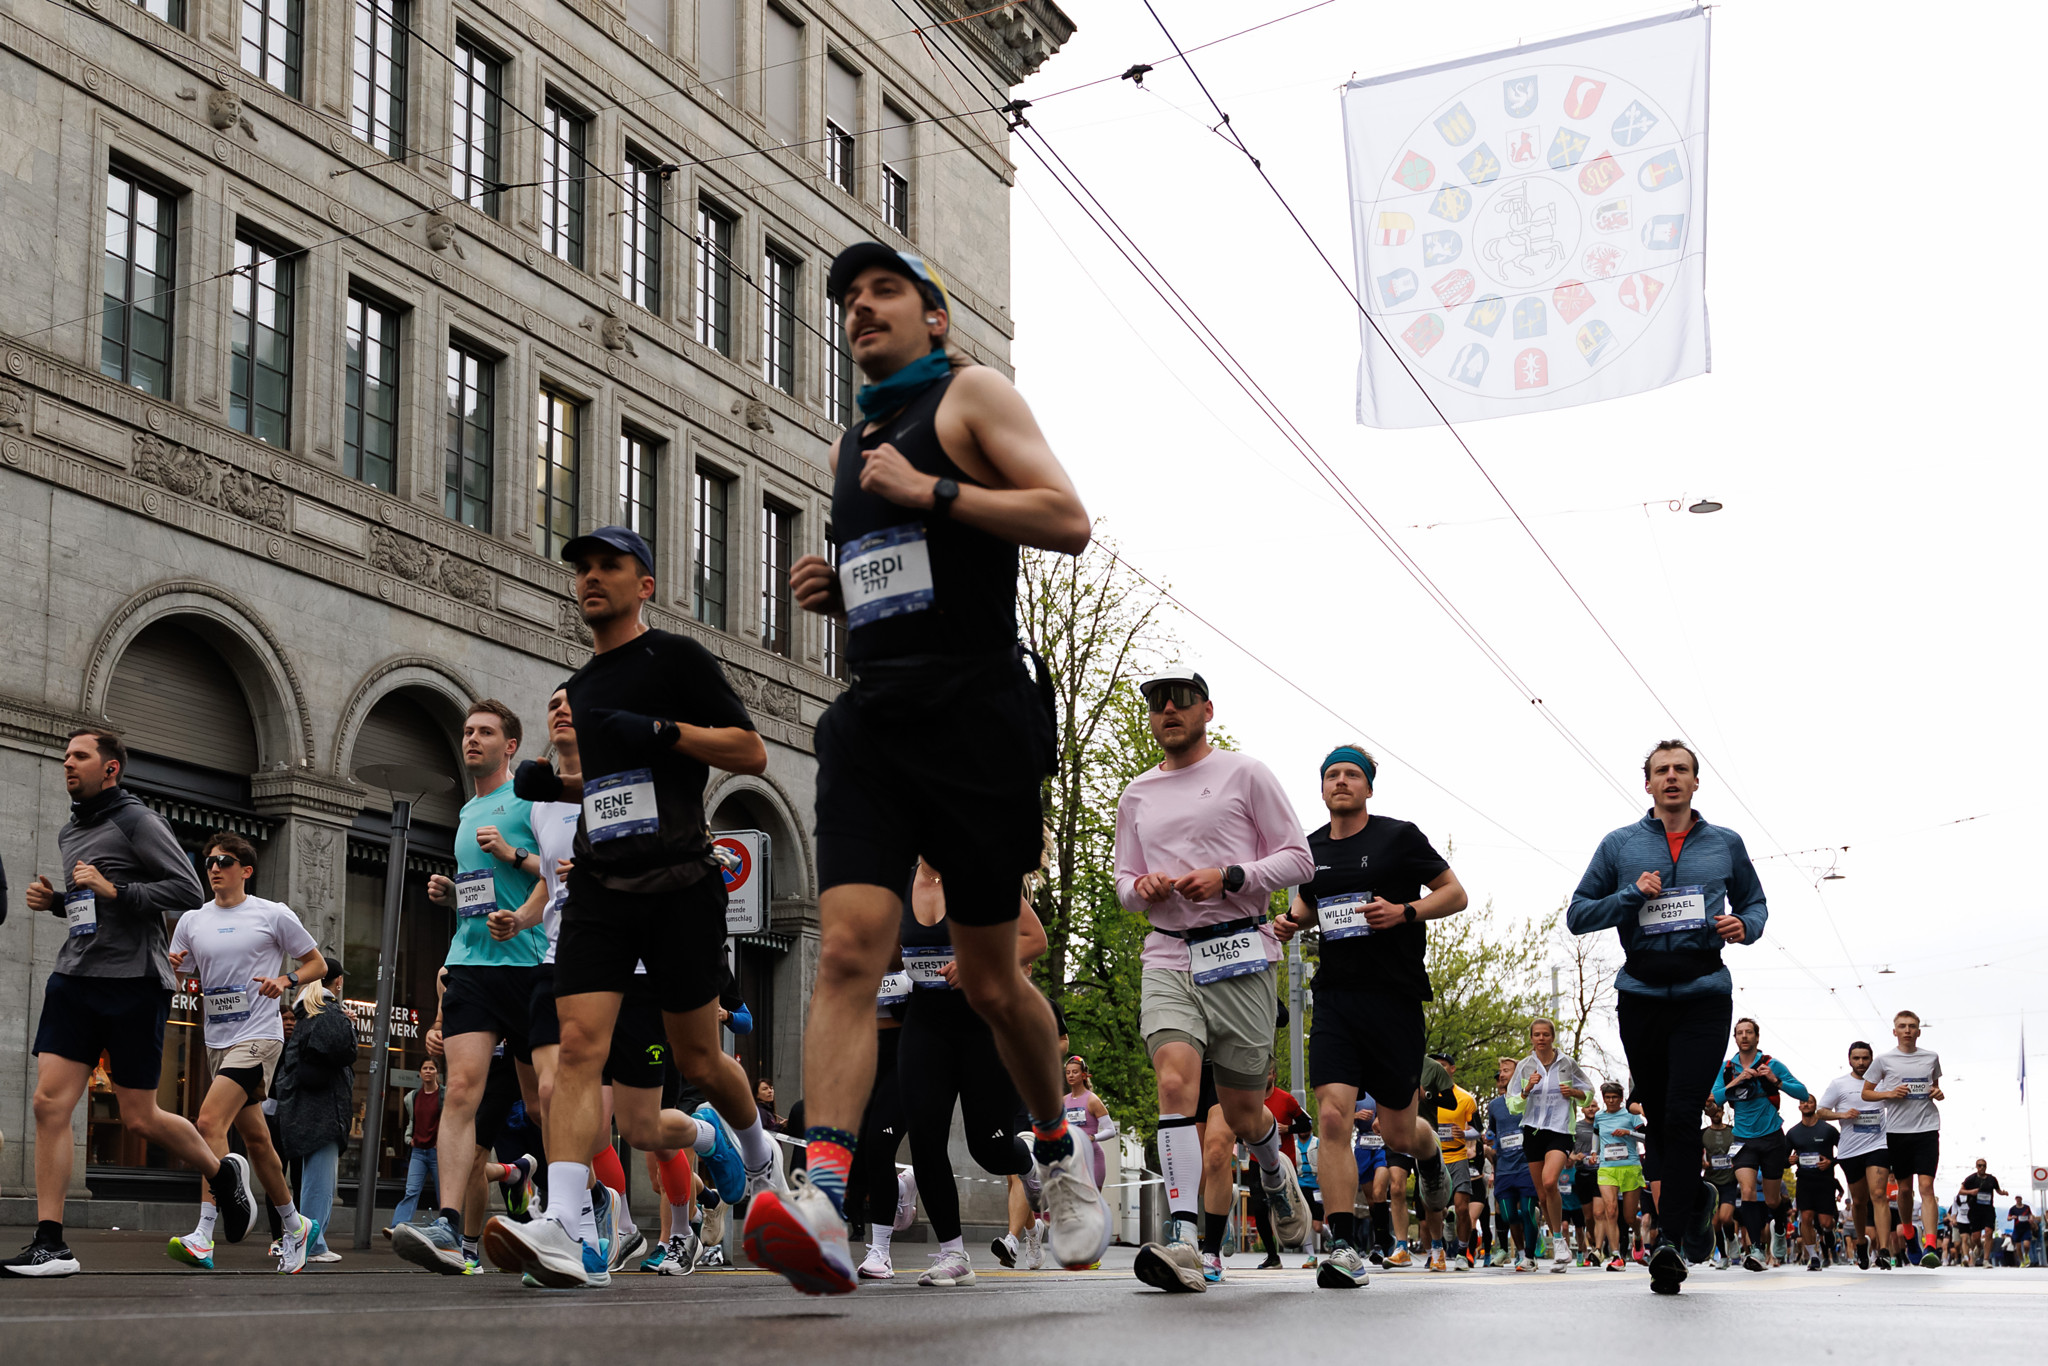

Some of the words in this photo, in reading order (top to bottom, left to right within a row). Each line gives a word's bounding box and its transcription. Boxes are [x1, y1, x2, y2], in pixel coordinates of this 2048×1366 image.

[851, 554, 903, 585] FERDI
[863, 576, 888, 595] 2717
[594, 791, 634, 813] RENE
[600, 806, 627, 820] 4366
[458, 884, 486, 896] MATTHIAS
[726, 905, 746, 914] hrende
[1647, 900, 1695, 913] RAPHAEL
[726, 914, 753, 923] umschlag
[1661, 910, 1683, 919] 6237
[1334, 917, 1352, 925] 4148
[1201, 938, 1250, 958] LUKAS
[1216, 950, 1240, 962] 7160
[880, 978, 898, 988] DA
[210, 995, 241, 1006] YANNIS
[341, 1000, 409, 1021] SCHWZER
[1165, 1131, 1176, 1187] COMPRESSPORT
